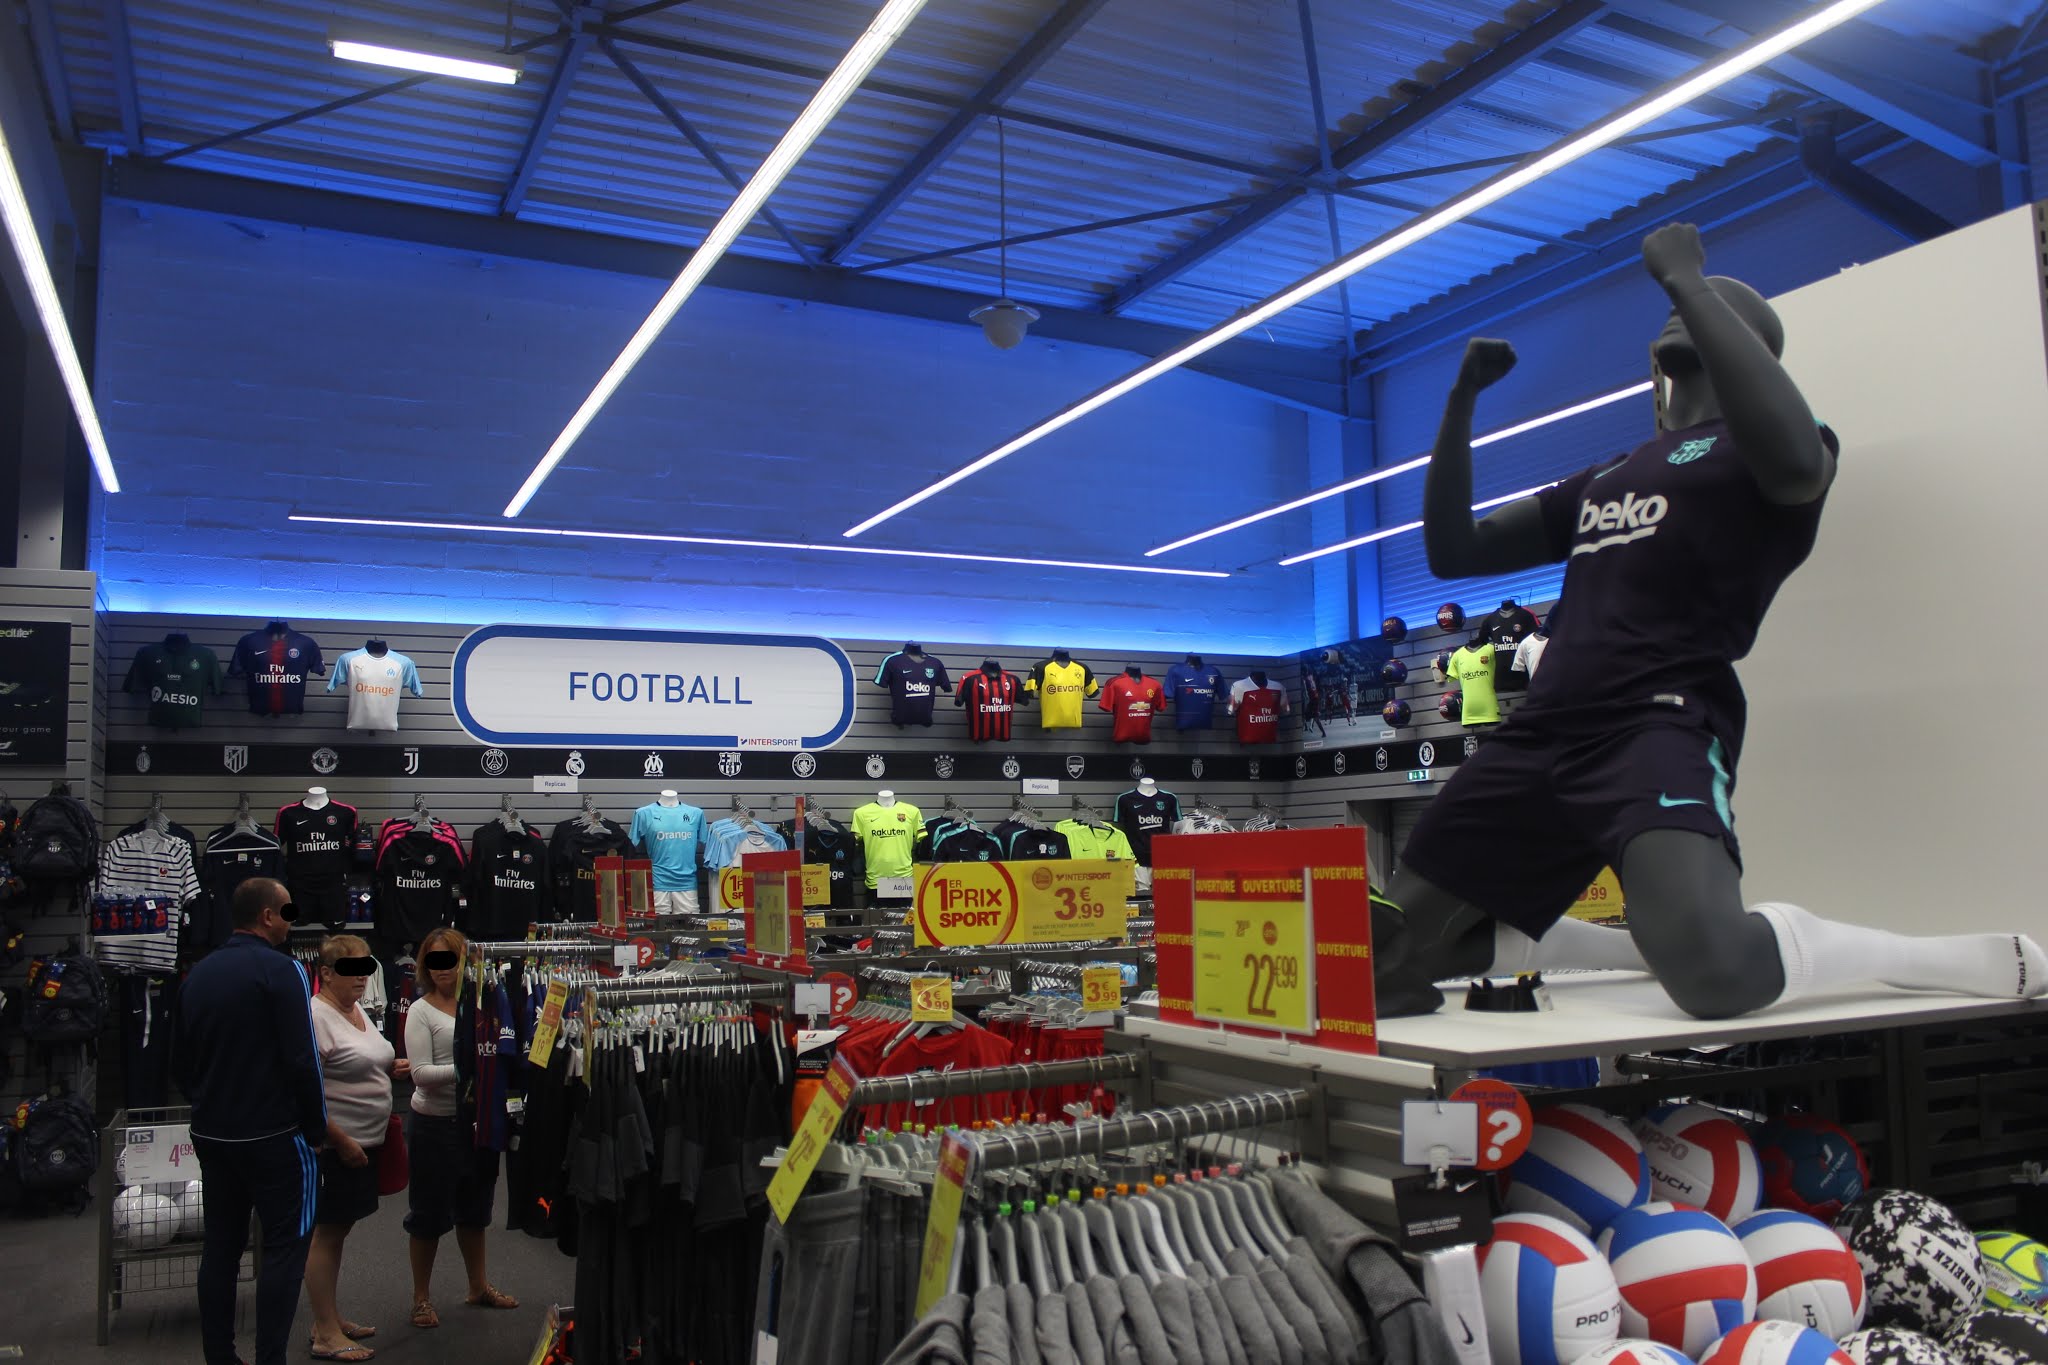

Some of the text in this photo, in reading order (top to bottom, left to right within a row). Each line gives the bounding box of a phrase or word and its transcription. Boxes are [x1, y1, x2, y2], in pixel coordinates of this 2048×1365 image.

[1577, 492, 1668, 534] beko
[1502, 635, 1513, 644] Fly
[1494, 642, 1520, 651] Emirat
[269, 664, 285, 674] Fly
[255, 672, 301, 684] Emirates
[356, 683, 394, 696] Orange
[569, 672, 753, 705] FOOTBALL
[906, 681, 930, 692] beko
[162, 693, 198, 705] AESIO
[23, 727, 52, 735] game
[748, 738, 798, 746] INTERSPORT
[1139, 814, 1163, 825] beko
[310, 831, 325, 841] Fly
[657, 830, 692, 842] Orange
[871, 828, 906, 837] Rakuten
[296, 840, 340, 853] Emirates
[411, 869, 425, 879] Fly
[506, 869, 519, 880] Fly
[1154, 868, 1192, 880] OUVERTURE
[1313, 866, 1365, 880] OUVERTURE
[396, 876, 442, 889] Emirates
[1196, 879, 1303, 894] OUVERTURE OUVERTURE
[950, 889, 1002, 908] PRIX
[939, 911, 1001, 928] SPORT
[1317, 942, 1369, 958] OUVERTURE
[1160, 997, 1193, 1011] OUVERTUR
[500, 1027, 515, 1036] eko
[1322, 1018, 1373, 1036] OUVERTURE
[1650, 1166, 1693, 1194] OUCH
[1575, 1311, 1609, 1328] PRO
